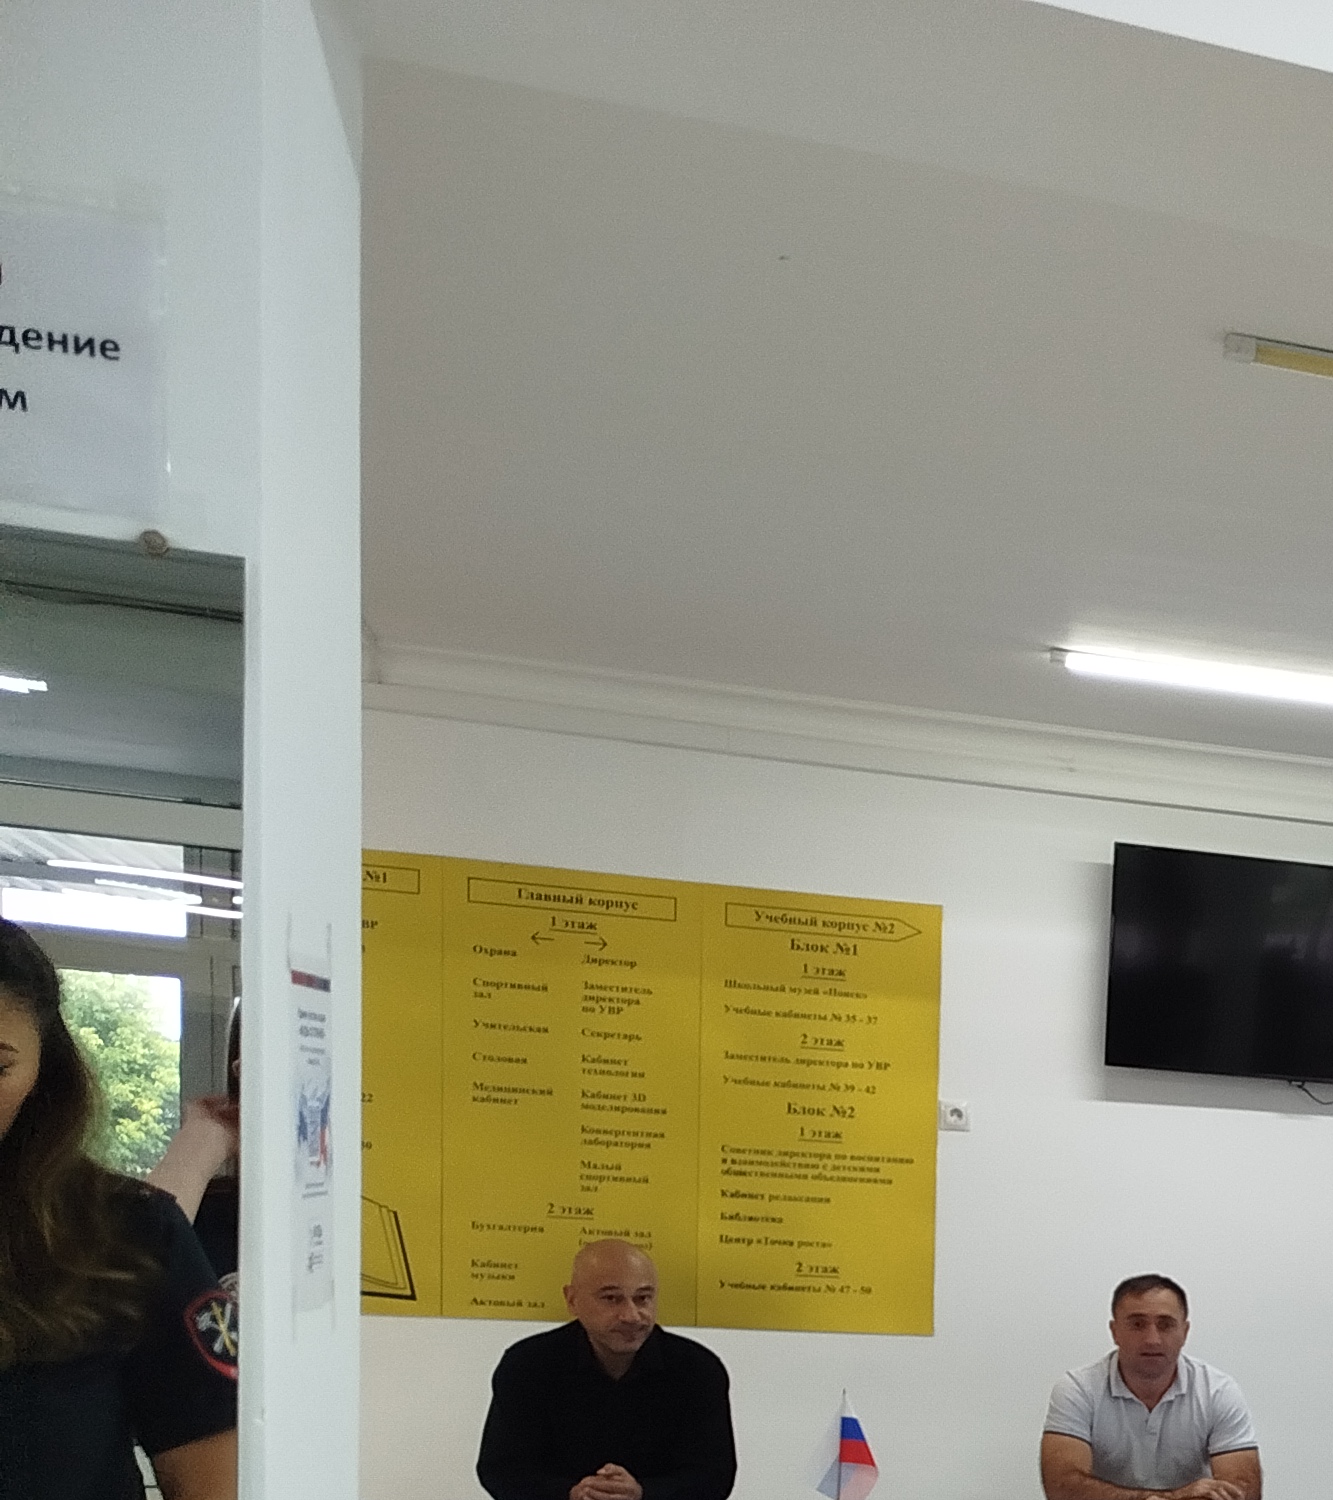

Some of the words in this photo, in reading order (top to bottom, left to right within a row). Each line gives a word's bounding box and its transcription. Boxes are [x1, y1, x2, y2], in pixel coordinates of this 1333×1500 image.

[517, 888, 583, 905] Главный
[588, 896, 638, 912] корпус
[551, 916, 556, 927] 1
[563, 919, 597, 930] этаж
[754, 910, 818, 927] Учебный
[822, 917, 868, 933] корпус
[872, 921, 895, 934] №2
[473, 944, 517, 957] Охрана
[790, 938, 829, 953] Блок
[833, 941, 858, 956] №1
[582, 954, 637, 969] Директор
[803, 964, 808, 974] 1
[815, 966, 846, 977] этаж
[473, 977, 548, 992] Спортивный
[583, 981, 653, 995] Заместитель
[724, 979, 786, 993] Школьный
[789, 986, 820, 996] музей
[473, 991, 491, 999] зал
[582, 994, 640, 1007] директора
[582, 1005, 595, 1014] по
[599, 1004, 624, 1015] УВР
[724, 1005, 772, 1017] Учебные
[775, 1010, 827, 1021] кабинеты
[830, 1013, 842, 1022] №
[845, 1014, 856, 1024] 35
[867, 1016, 878, 1025] 37
[473, 1018, 548, 1033] Учительская
[581, 1028, 642, 1042] Секретарь
[801, 1034, 808, 1044] 2
[812, 1036, 845, 1047] этаж
[472, 1052, 527, 1064] Столовая
[581, 1054, 628, 1066] Кабинет
[724, 1051, 791, 1064] Заместитель
[795, 1057, 849, 1069] директора
[852, 1060, 864, 1068] по
[867, 1060, 891, 1070] УВР
[582, 1067, 645, 1078] технологии
[473, 1081, 553, 1096] Медицинский
[722, 1075, 771, 1087] Учебные
[773, 1080, 826, 1090] кабинеты
[828, 1082, 841, 1092] №
[865, 1085, 876, 1094] 42
[472, 1094, 518, 1105] кабинет
[581, 1089, 628, 1101] Кабинет
[581, 1102, 667, 1115] моделирования
[787, 1102, 825, 1116] Блок
[830, 1105, 856, 1118] №2
[581, 1124, 665, 1138] Конвергентная
[800, 1127, 804, 1136] 1
[810, 1129, 843, 1139] этаж
[582, 1137, 651, 1150] лаборатория
[580, 1160, 621, 1171] Малый
[580, 1173, 649, 1184] спортивный
[580, 1184, 598, 1193] зал
[721, 1189, 765, 1200] Кабинет
[546, 1203, 554, 1214] 2
[560, 1205, 594, 1216] этаж
[720, 1212, 783, 1223] Библиотека
[471, 1221, 544, 1234] Бухгалтерия
[580, 1226, 630, 1237] Актовый
[719, 1234, 754, 1246] Центр
[471, 1259, 518, 1270] Кабинет
[796, 1262, 803, 1272] 2
[808, 1265, 840, 1274] этаж
[471, 1272, 515, 1281] музыки
[719, 1280, 767, 1291] Учебные
[770, 1283, 821, 1294] кабинеты
[824, 1284, 836, 1294] №
[471, 1297, 523, 1308] Актовый
